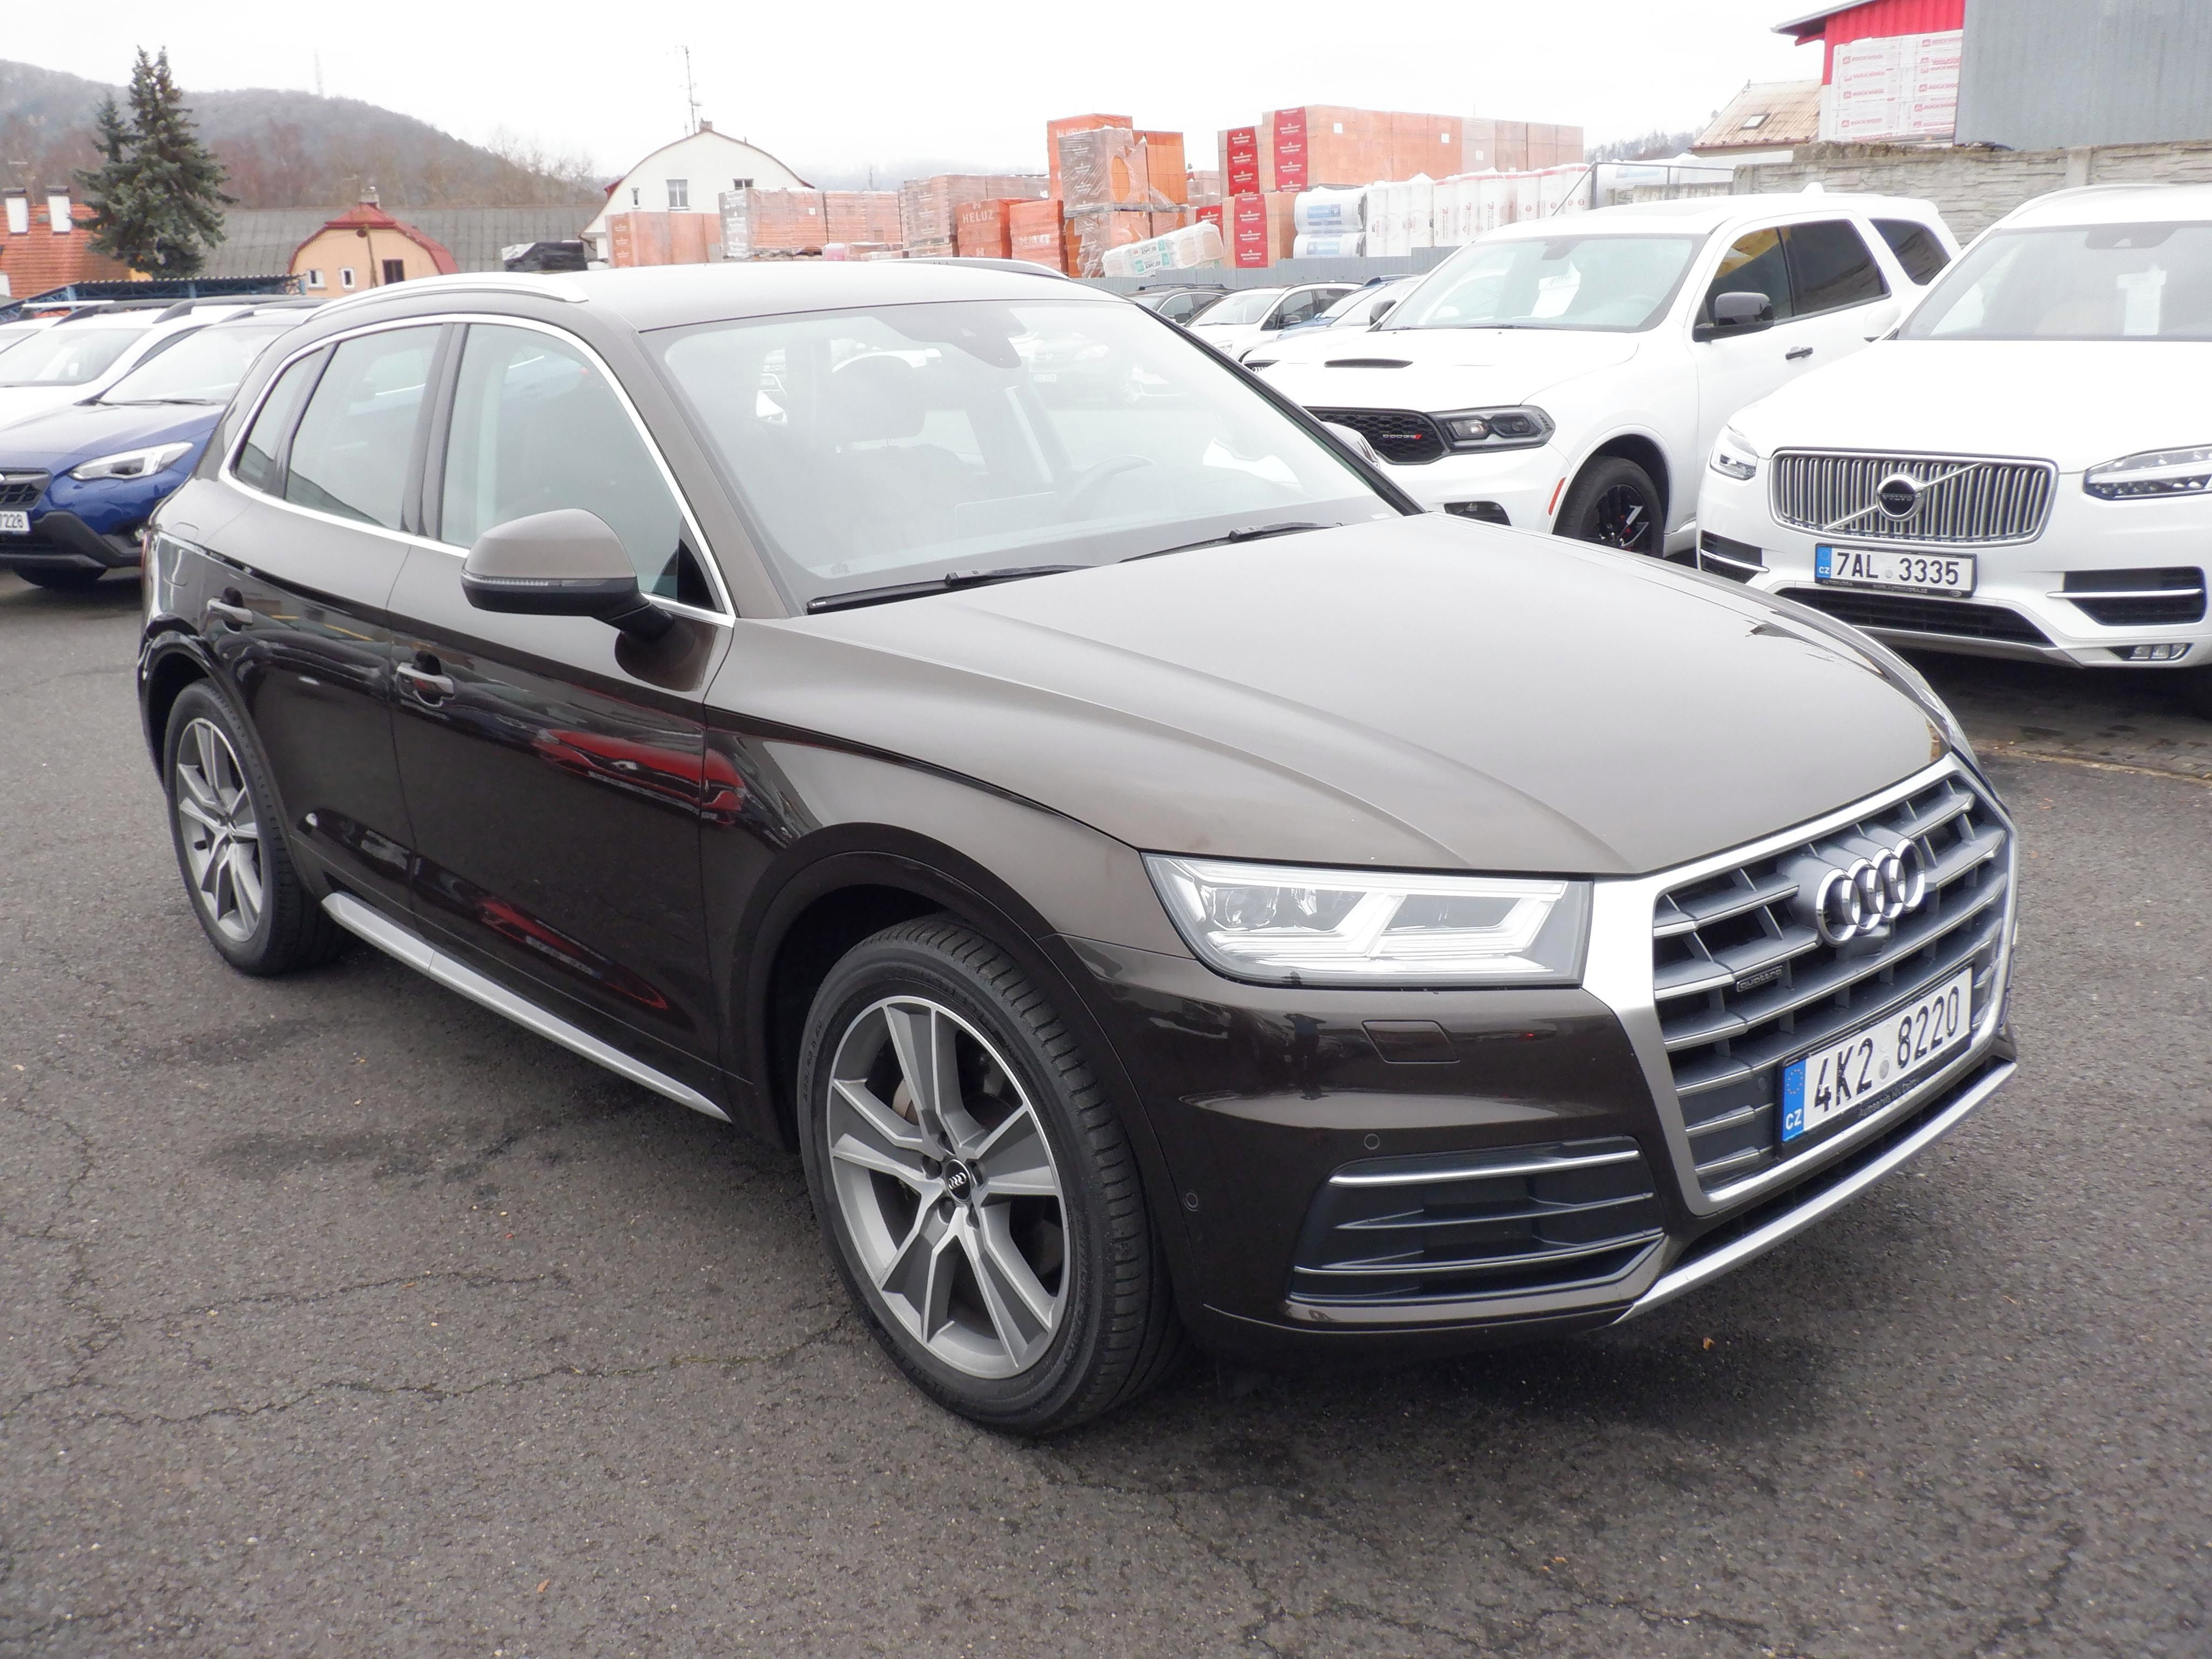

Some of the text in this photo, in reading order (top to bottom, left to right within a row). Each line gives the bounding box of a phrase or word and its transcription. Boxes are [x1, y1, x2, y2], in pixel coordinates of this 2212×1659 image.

[962, 209, 994, 224] HELUZ
[1818, 565, 1831, 574] CZ
[1837, 551, 1959, 585] 7AL 3335
[1739, 967, 1782, 990] quattro
[1814, 1037, 1873, 1112] 4K2
[1897, 984, 1959, 1069] 8220
[1785, 1109, 1802, 1131] CZ
